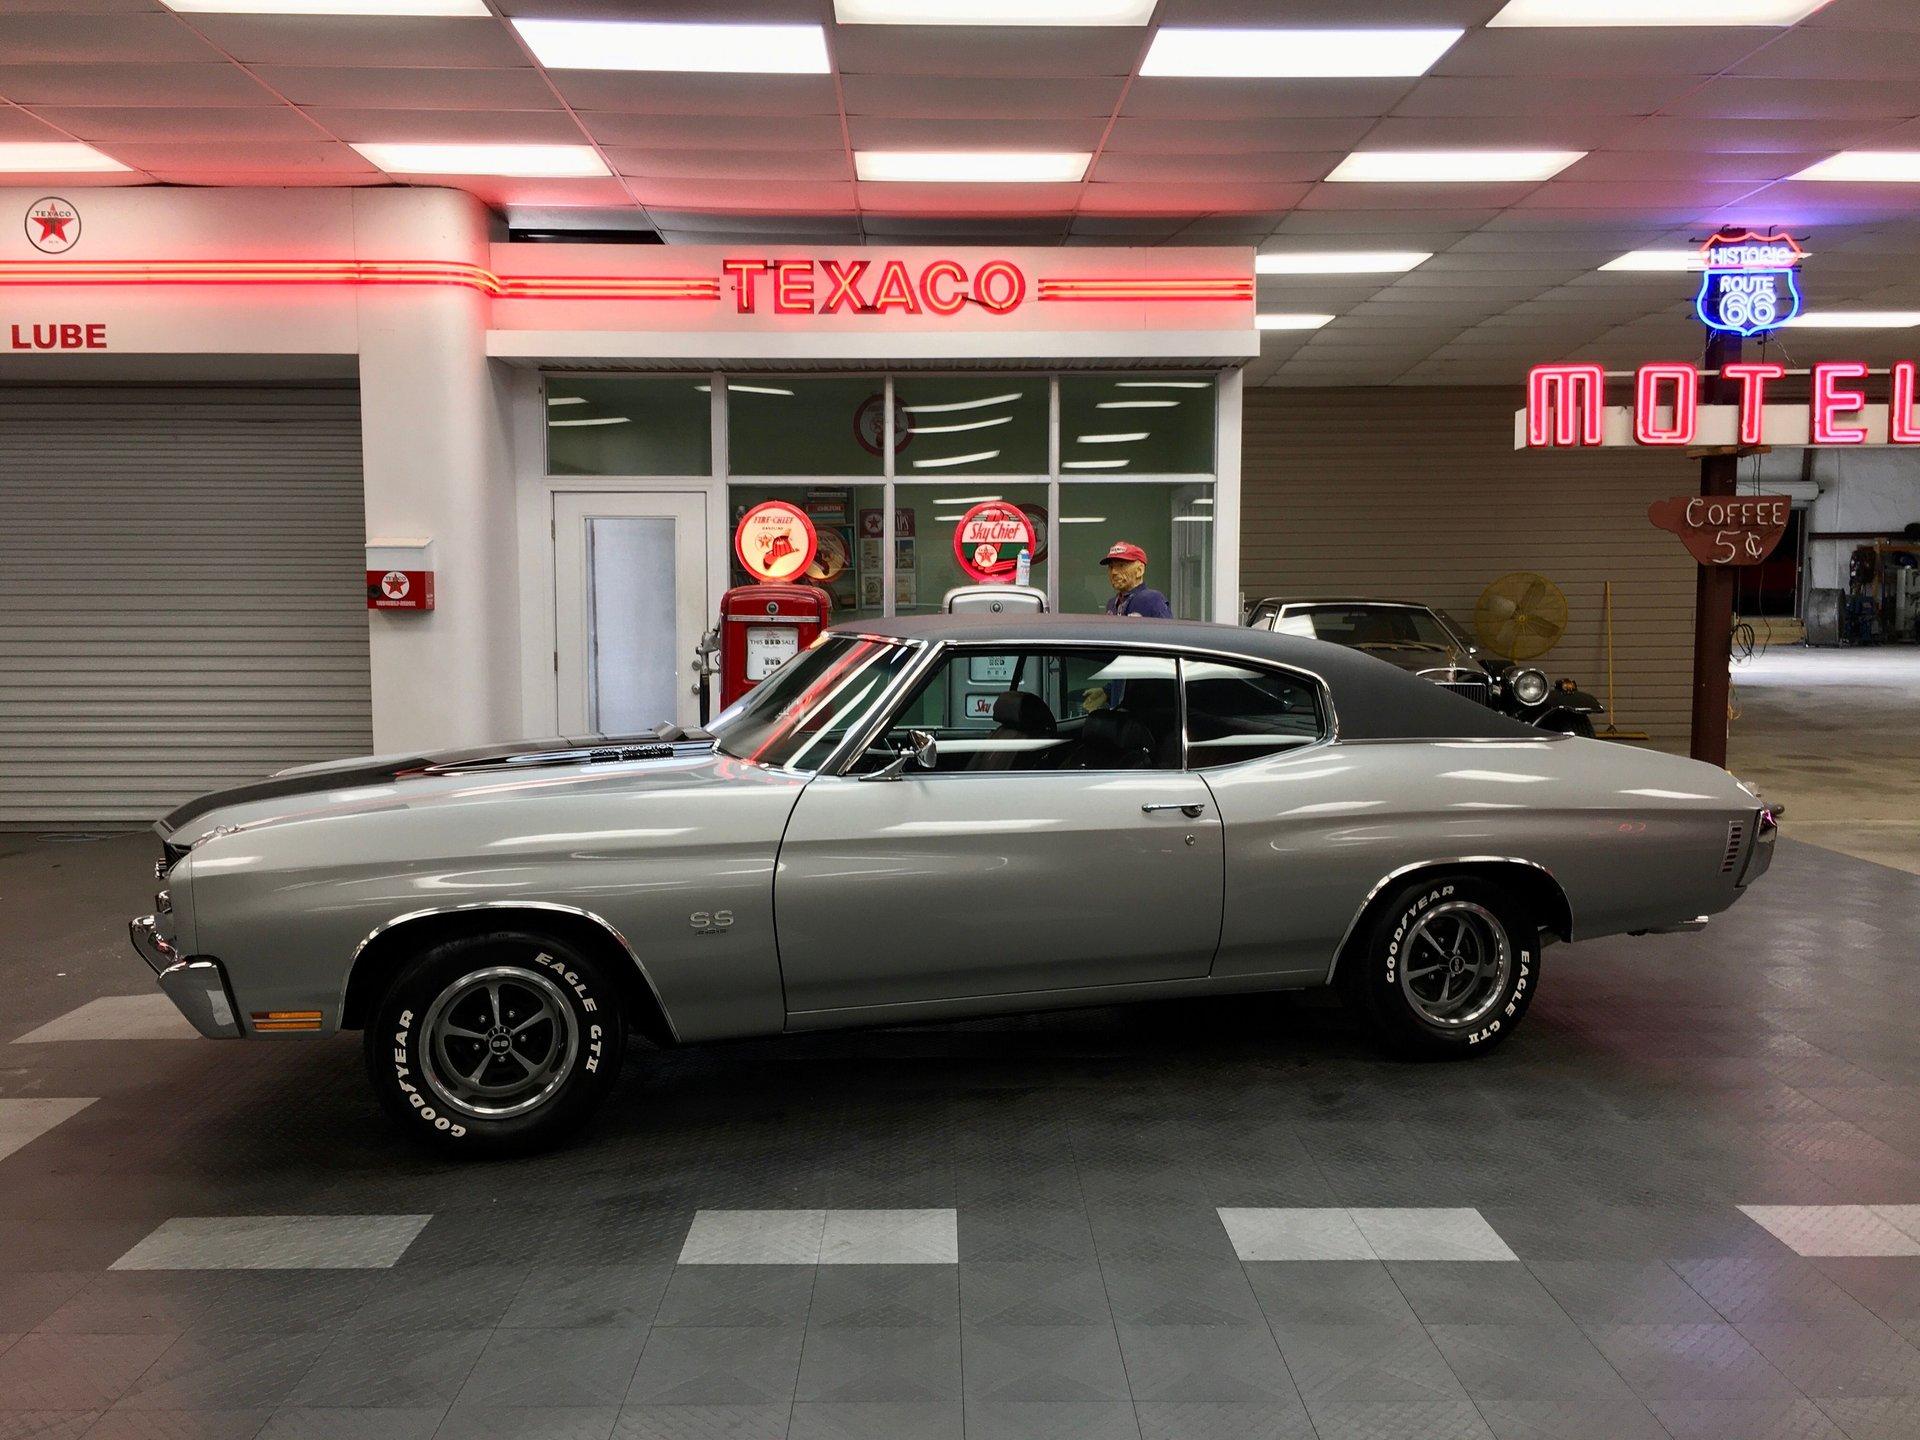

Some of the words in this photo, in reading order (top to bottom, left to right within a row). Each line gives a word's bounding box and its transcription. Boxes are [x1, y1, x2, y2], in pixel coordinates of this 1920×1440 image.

[1710, 246, 1789, 265] HISTORIC
[723, 260, 1026, 315] TEXACO
[1720, 275, 1775, 293] ROUTE
[1719, 291, 1776, 327] 66
[12, 324, 107, 349] LUBE
[1526, 363, 1920, 446] MOTEL
[1686, 498, 1785, 527] COFFEE
[970, 523, 990, 542] Sky
[991, 523, 1020, 540] Chief
[1712, 531, 1763, 563] 5¢
[975, 700, 991, 713] Sky
[689, 909, 734, 928] SS
[1386, 885, 1455, 983] GOODYEAR
[534, 952, 598, 1012] EAGLE
[1504, 950, 1530, 1017] EAGLE
[394, 1010, 466, 1137] GOODYEAR
